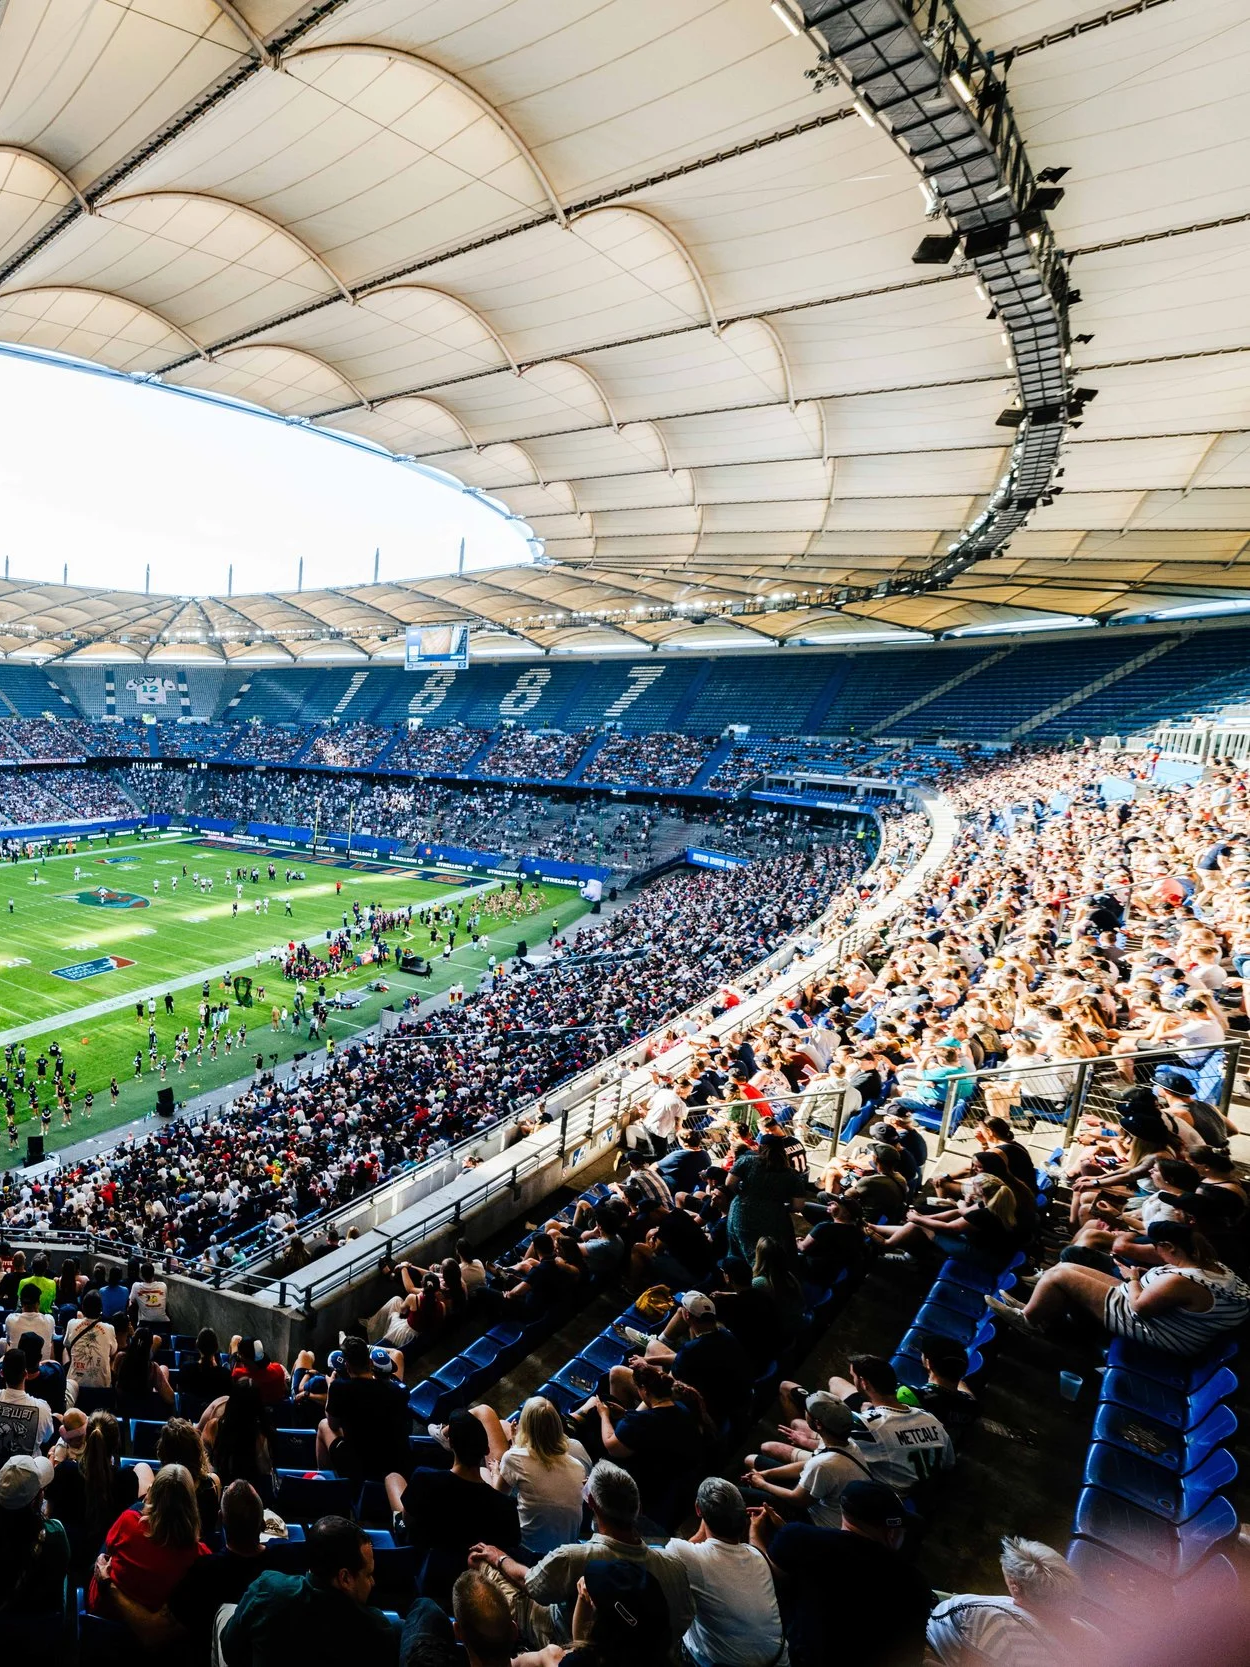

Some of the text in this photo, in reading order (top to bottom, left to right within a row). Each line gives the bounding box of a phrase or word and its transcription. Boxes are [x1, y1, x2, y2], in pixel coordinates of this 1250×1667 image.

[142, 685, 159, 693] 12
[389, 855, 417, 864] STRELLSON
[435, 861, 466, 871] STRELLSON
[486, 868, 520, 878] STRELLSON
[542, 876, 577, 886] STRELLSON
[895, 1426, 940, 1446] METCALF
